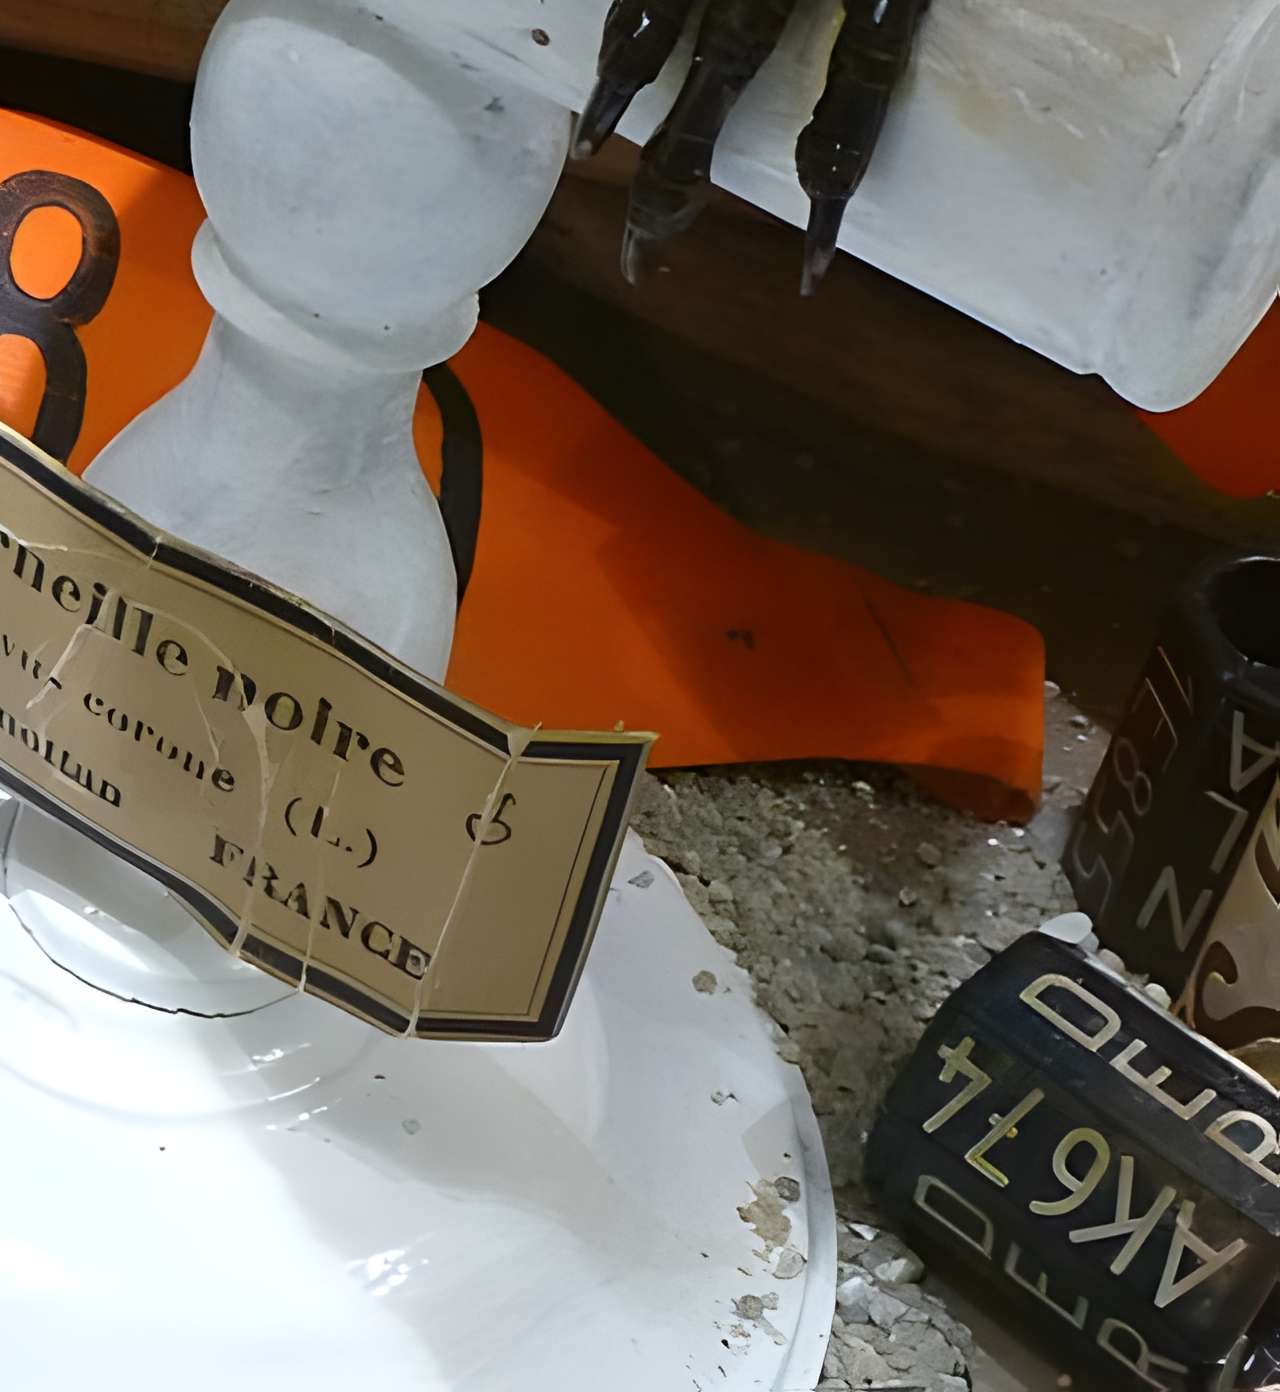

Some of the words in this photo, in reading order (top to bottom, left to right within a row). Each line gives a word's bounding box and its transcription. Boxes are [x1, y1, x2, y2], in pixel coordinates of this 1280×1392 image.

[212, 665, 406, 788] noire
[209, 832, 433, 981] FRANCE
[922, 1036, 1248, 1308] AK674
